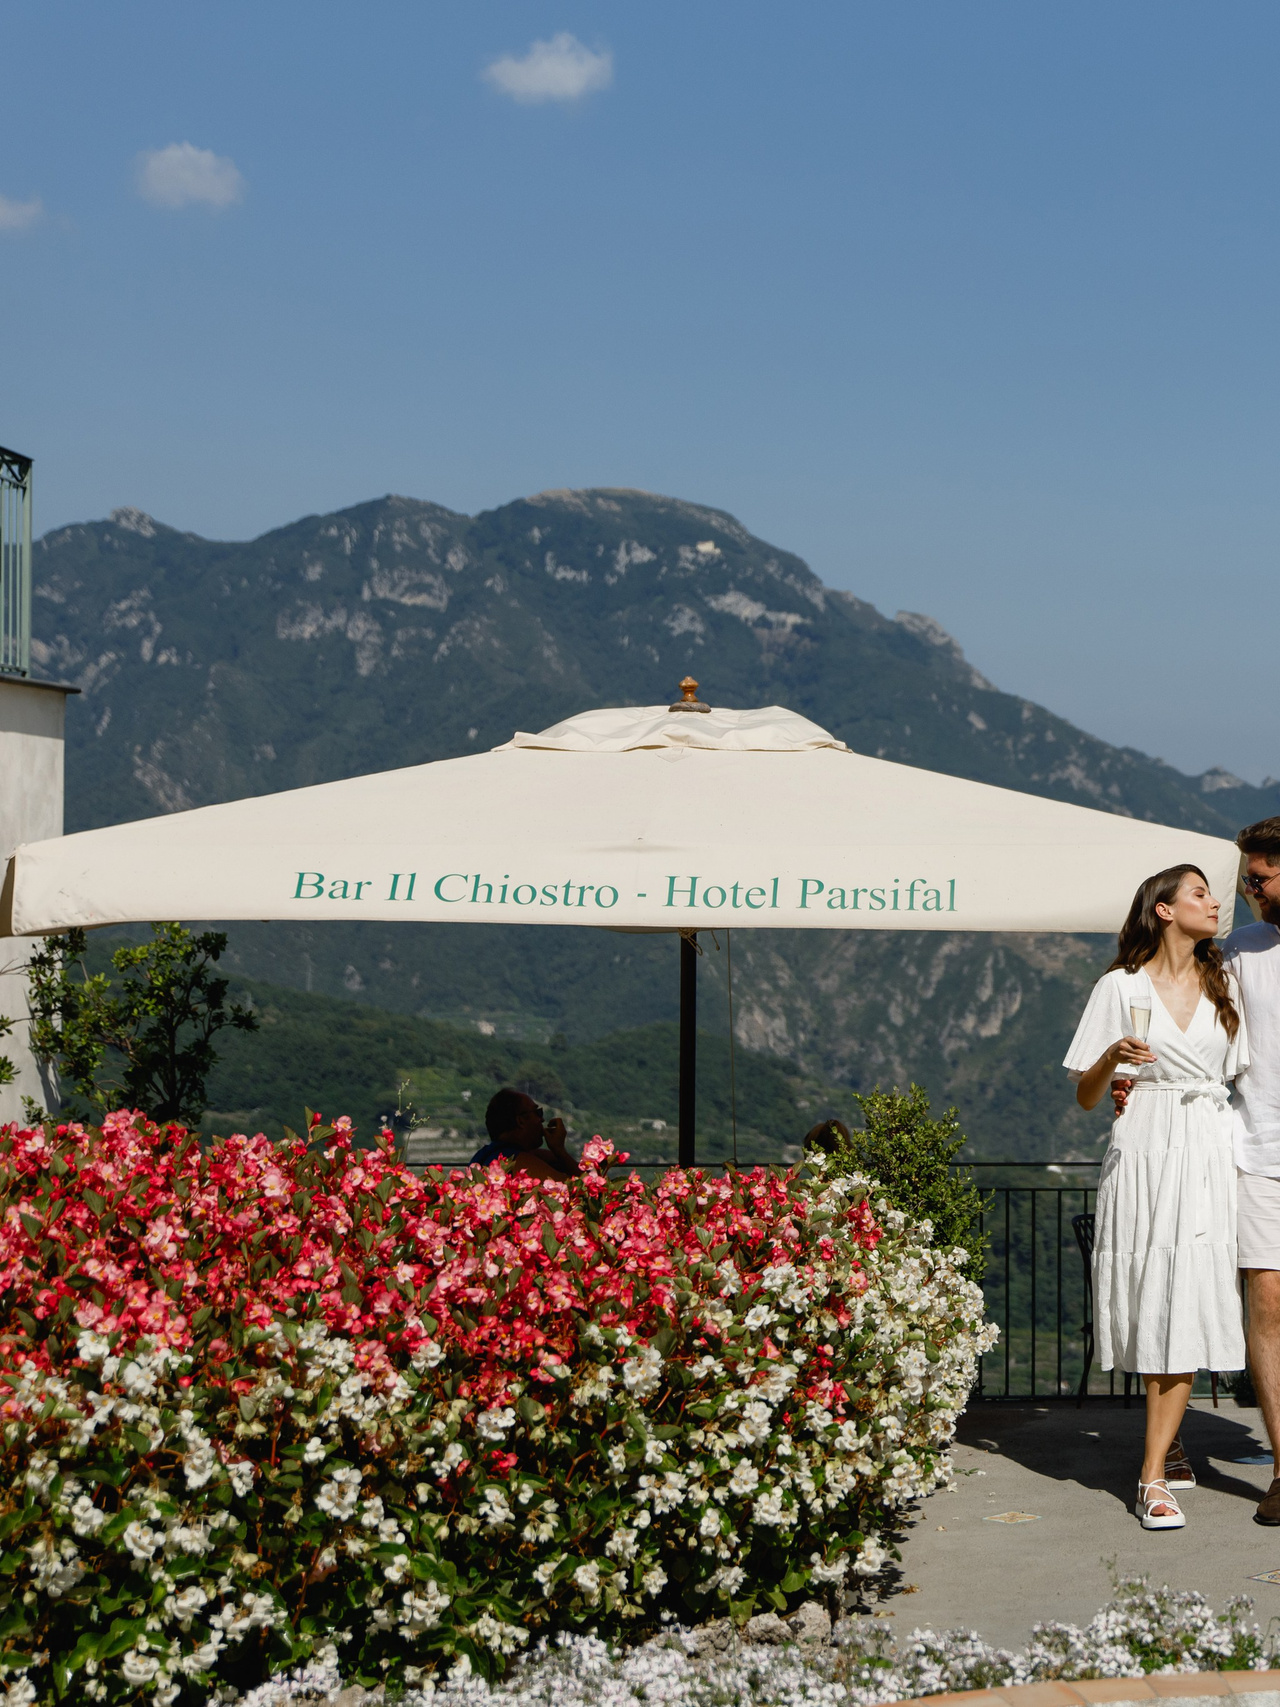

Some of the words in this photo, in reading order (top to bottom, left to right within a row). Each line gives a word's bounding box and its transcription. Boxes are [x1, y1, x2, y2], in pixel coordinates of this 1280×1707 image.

[290, 871, 373, 900] Bar
[384, 872, 417, 902] Il
[433, 872, 620, 909] Chiostro
[662, 875, 781, 909] Hotel
[795, 878, 959, 912] Parsifal
